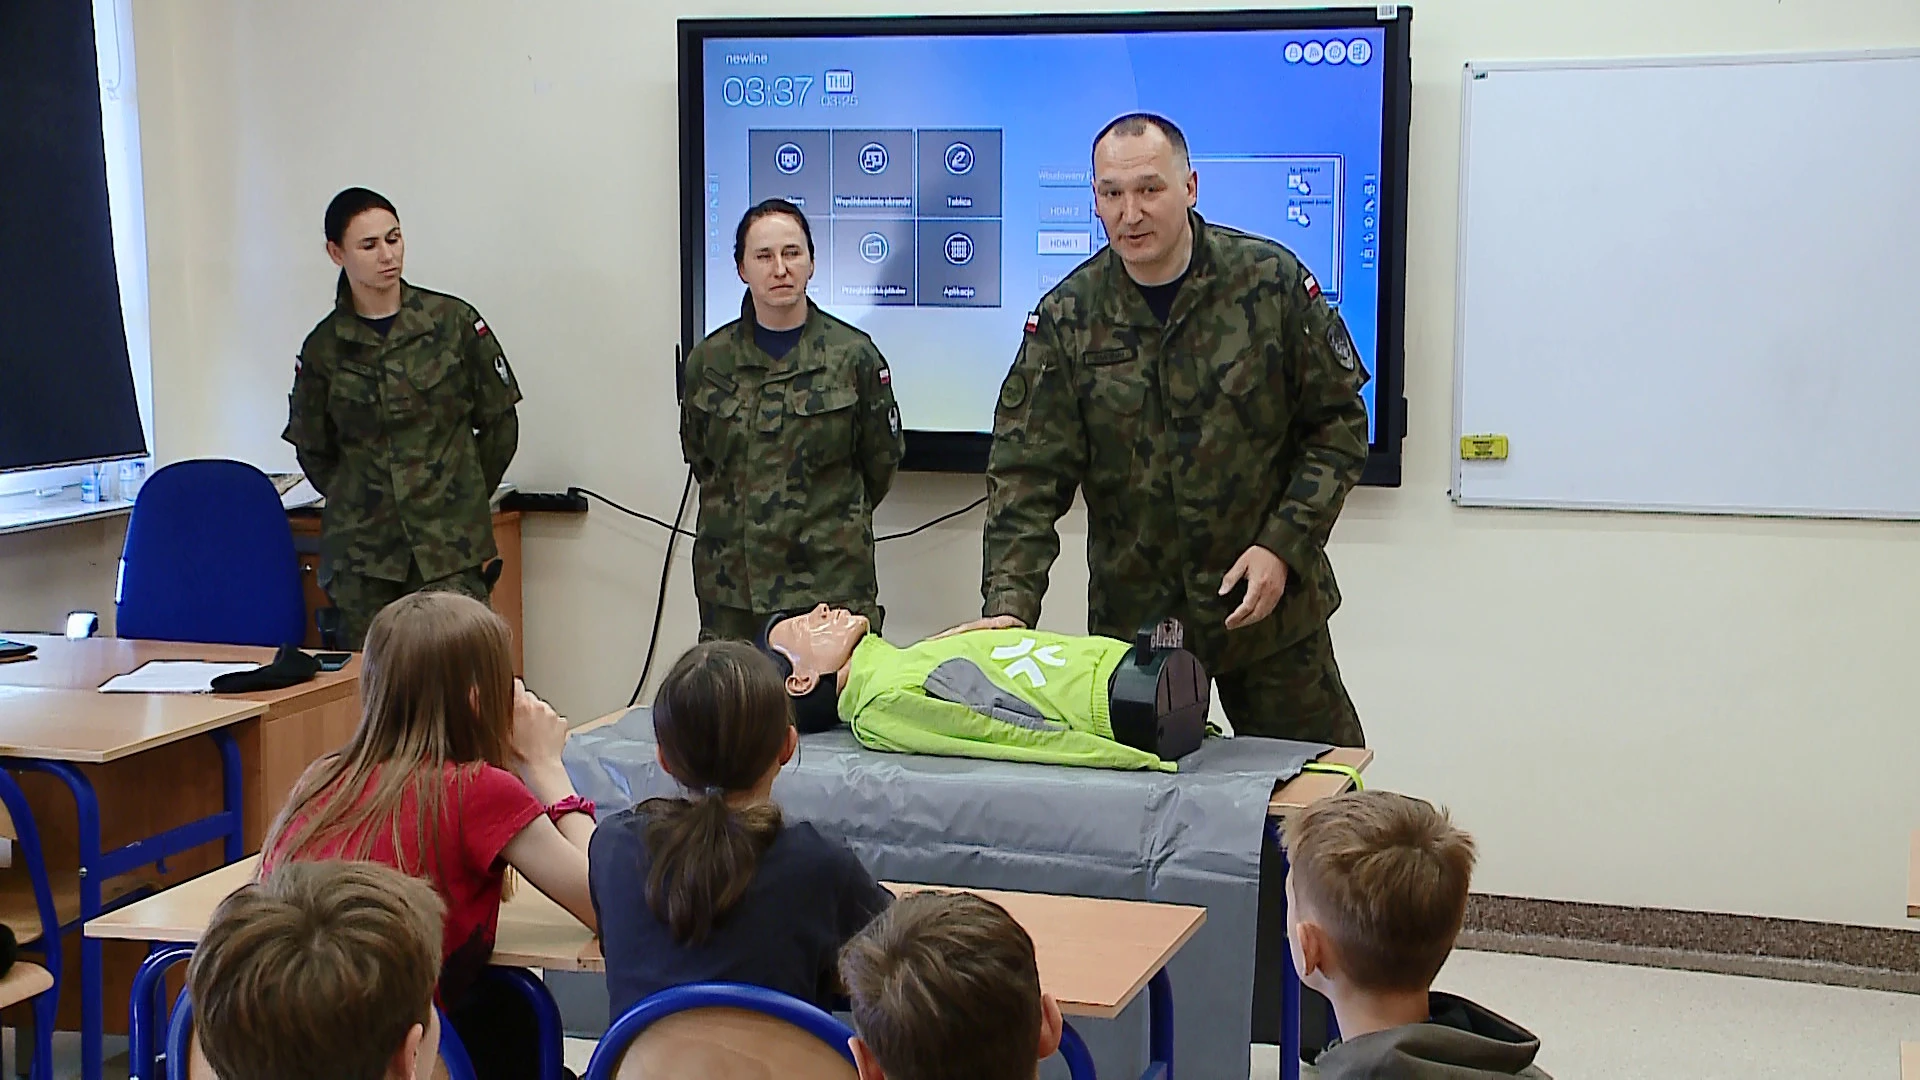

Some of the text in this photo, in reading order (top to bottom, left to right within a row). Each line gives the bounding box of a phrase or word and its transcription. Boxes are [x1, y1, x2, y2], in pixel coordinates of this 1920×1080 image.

[828, 75, 850, 88] THU
[723, 76, 814, 106] 03:37
[1050, 207, 1072, 216] HDMI
[1050, 239, 1072, 249] HDMI
